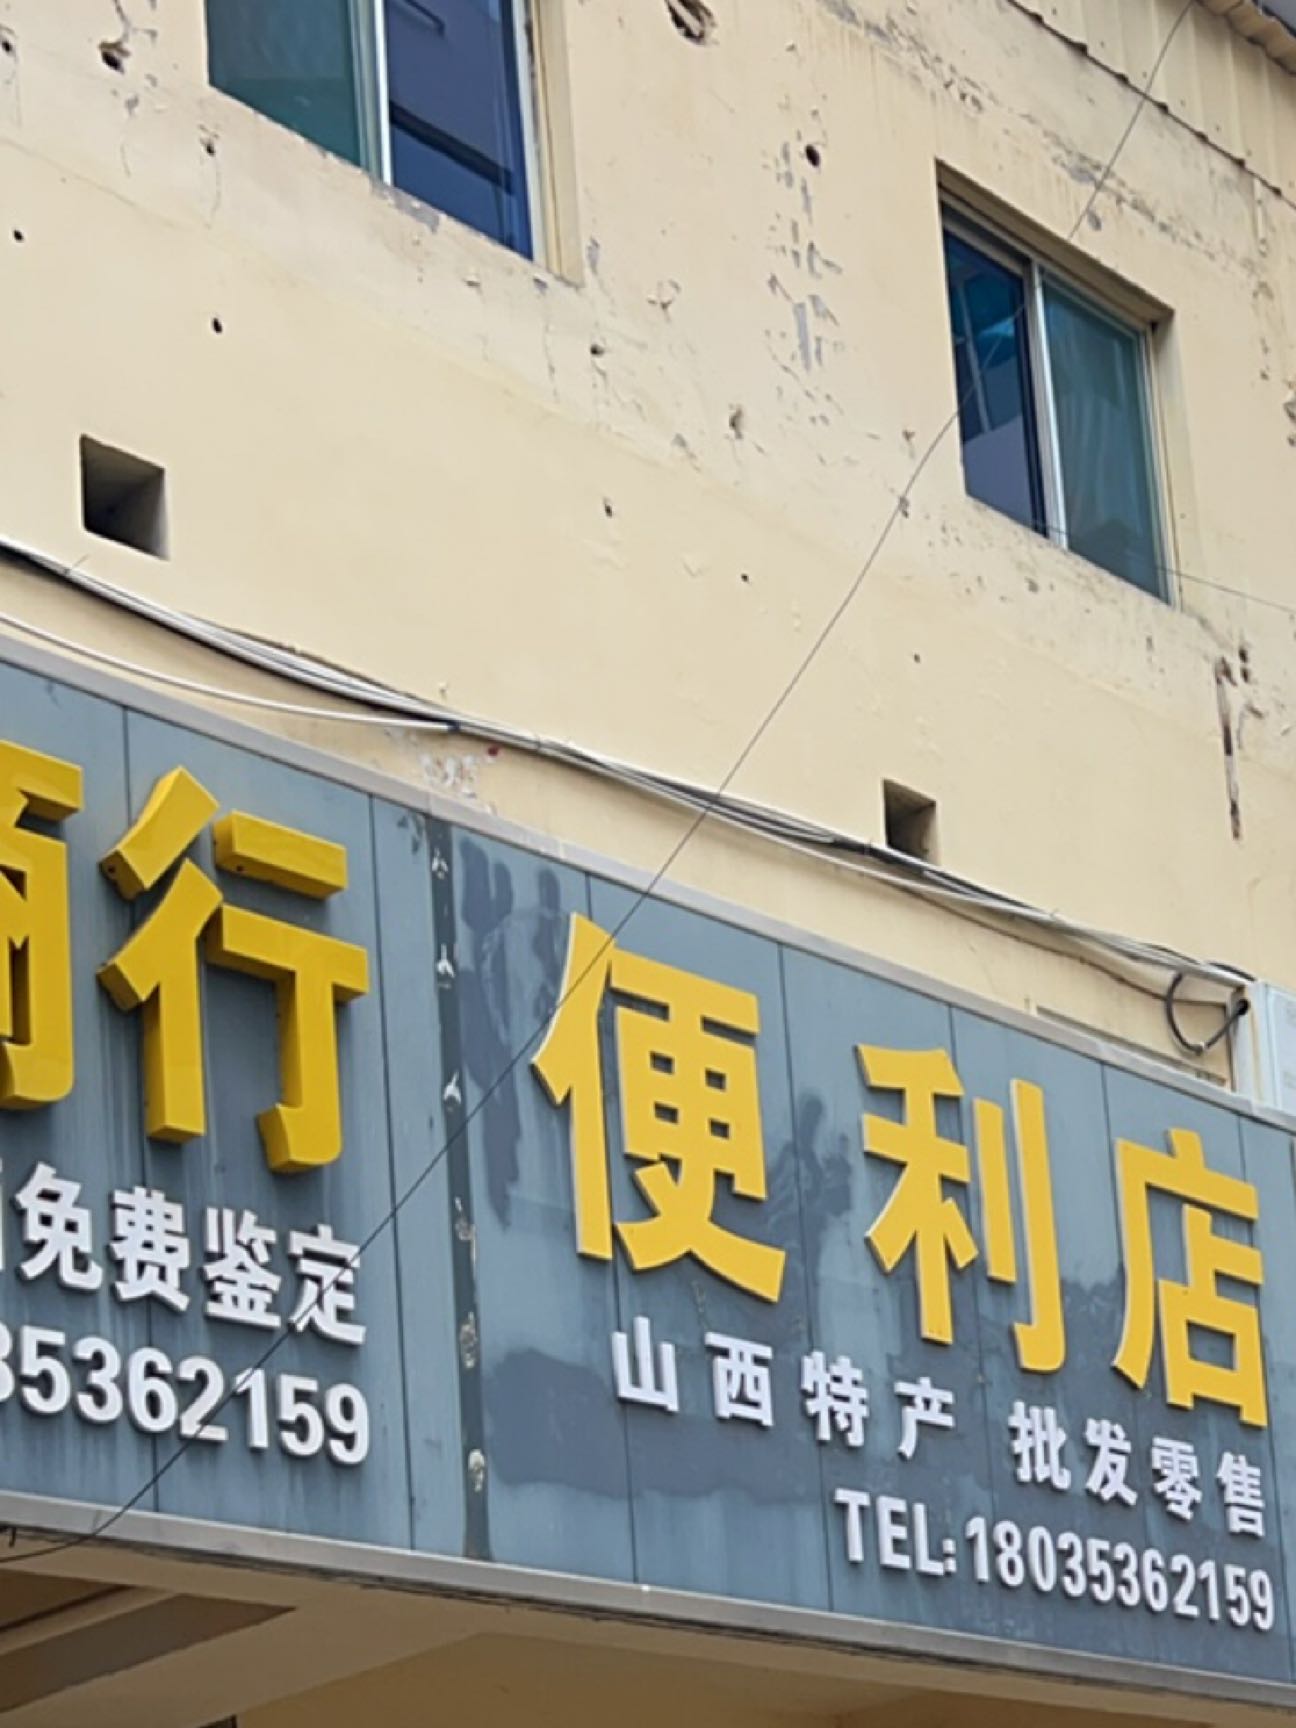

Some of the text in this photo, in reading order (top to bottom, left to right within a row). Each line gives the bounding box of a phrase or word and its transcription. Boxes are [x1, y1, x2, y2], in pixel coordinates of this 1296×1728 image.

[531, 912, 1268, 1428] 便利店
[15, 1161, 367, 1346] 免费鉴定
[611, 1316, 955, 1460] 山西特产
[1008, 1400, 1267, 1540] 批发零售
[834, 1487, 1275, 1631] TEL:18035362159
